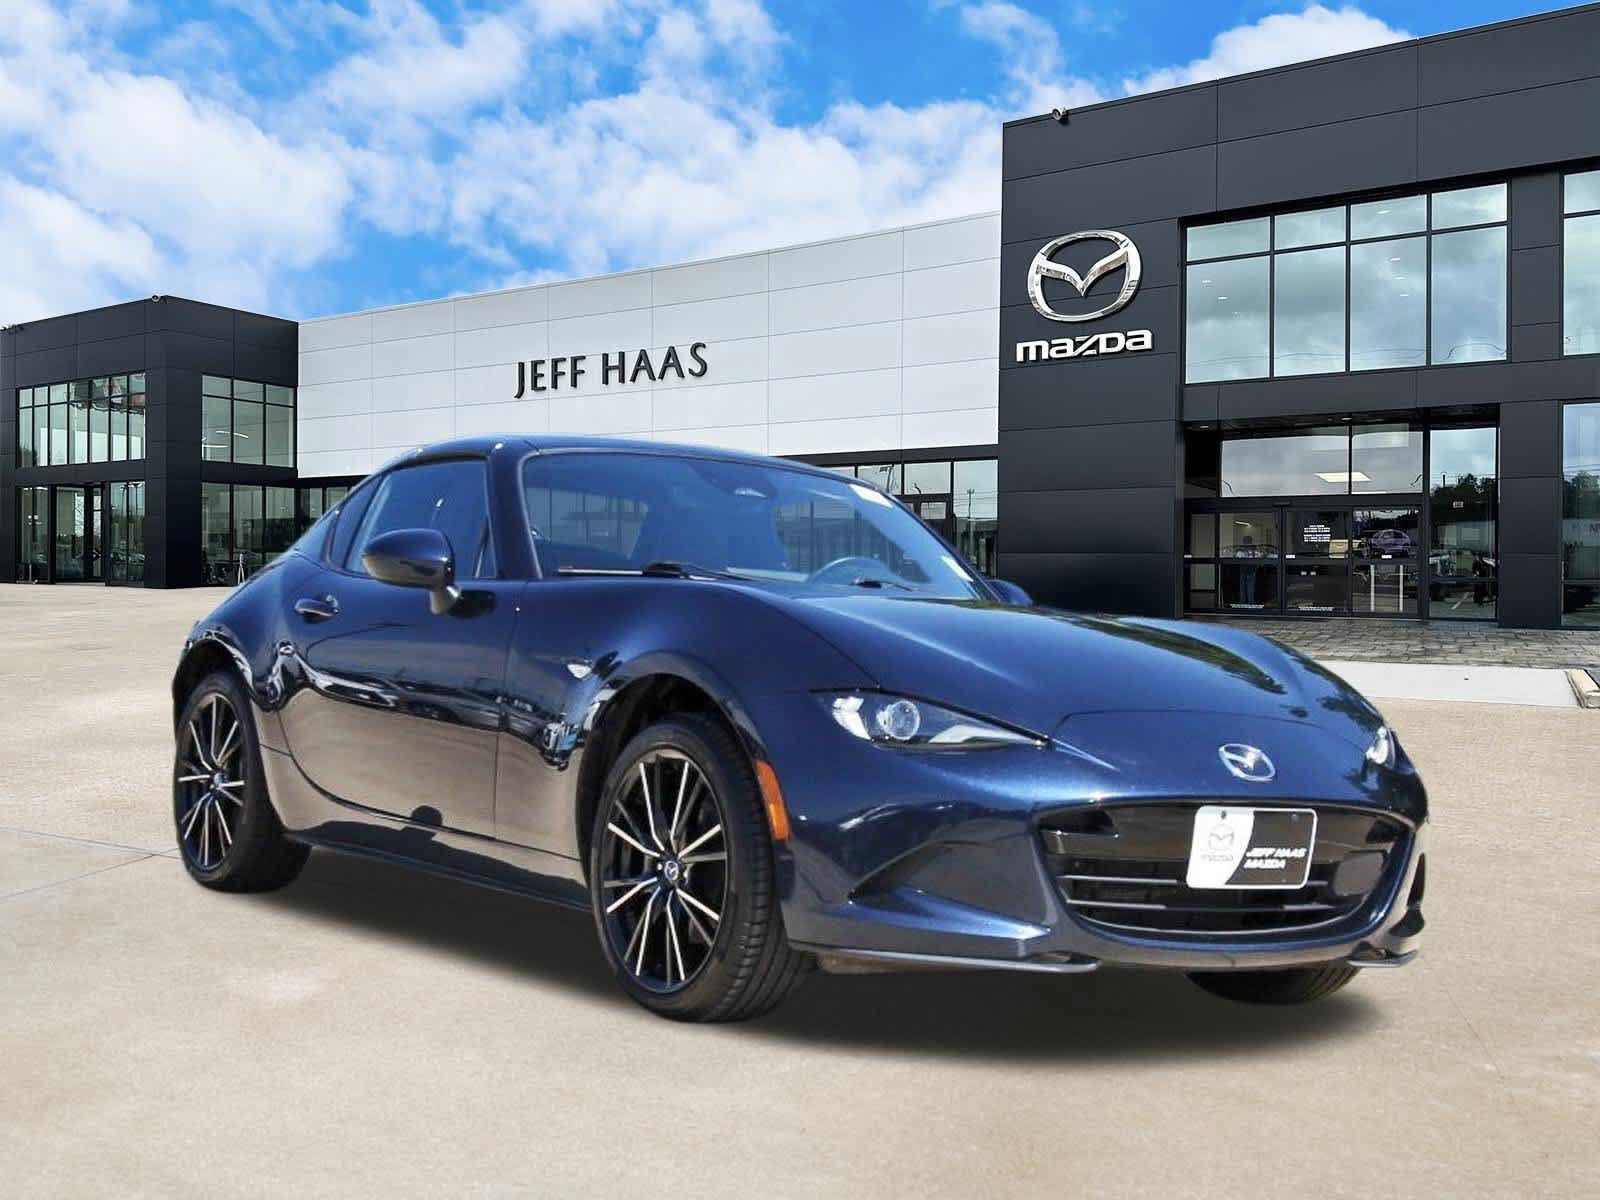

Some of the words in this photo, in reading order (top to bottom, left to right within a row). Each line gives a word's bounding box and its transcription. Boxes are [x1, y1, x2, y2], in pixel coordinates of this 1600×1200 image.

[513, 355, 587, 400] JEFF
[601, 342, 708, 386] HAAS
[1246, 847, 1276, 858] JEFF
[1273, 847, 1307, 858] HAAS
